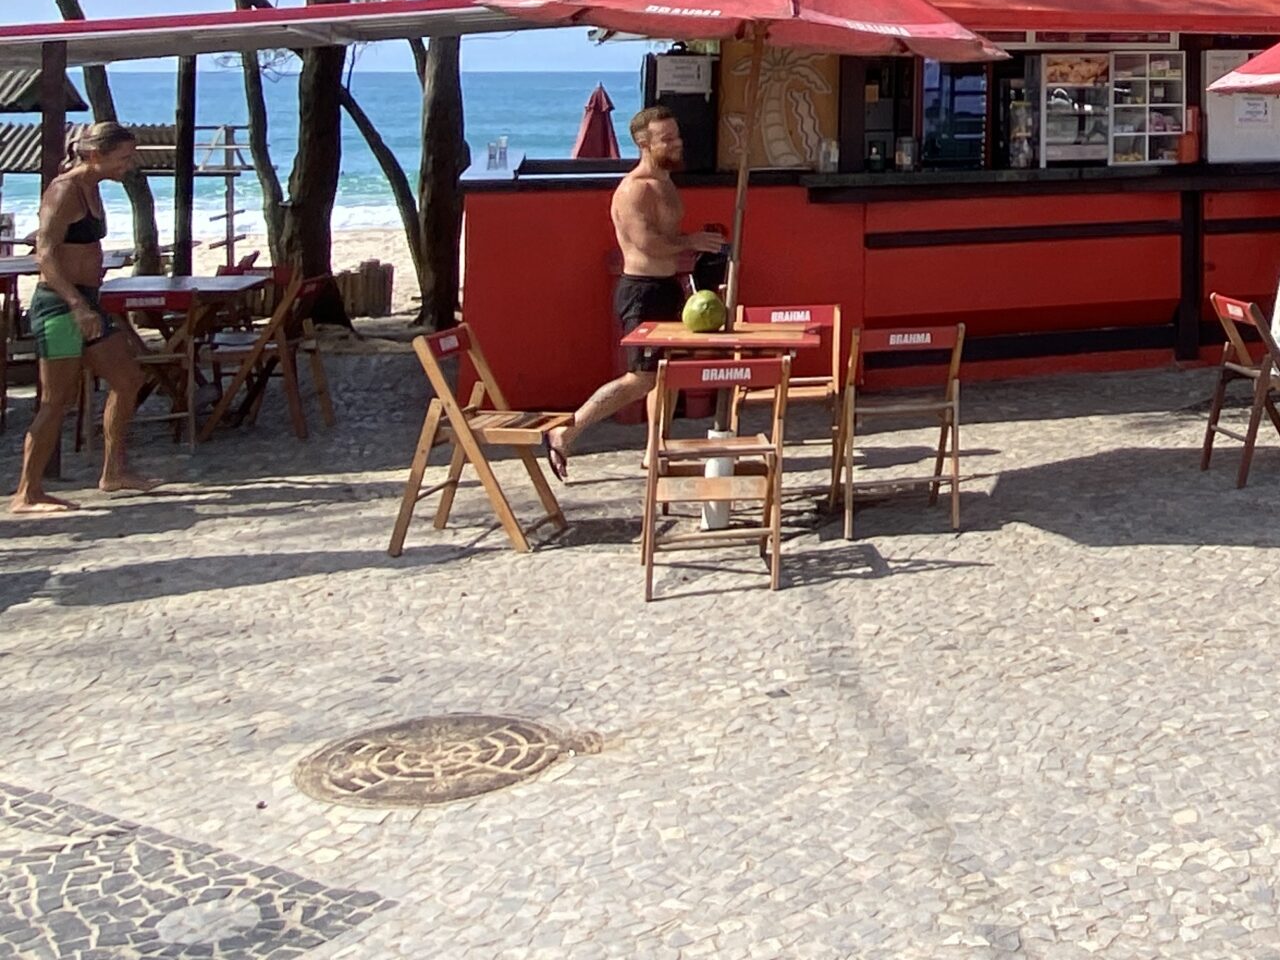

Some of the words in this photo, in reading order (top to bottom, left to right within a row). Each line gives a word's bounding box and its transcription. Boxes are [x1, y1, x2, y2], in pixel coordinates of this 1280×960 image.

[771, 310, 811, 323] BRAHMA
[889, 332, 932, 346] BRAHMA
[702, 367, 751, 381] BRAHMA
